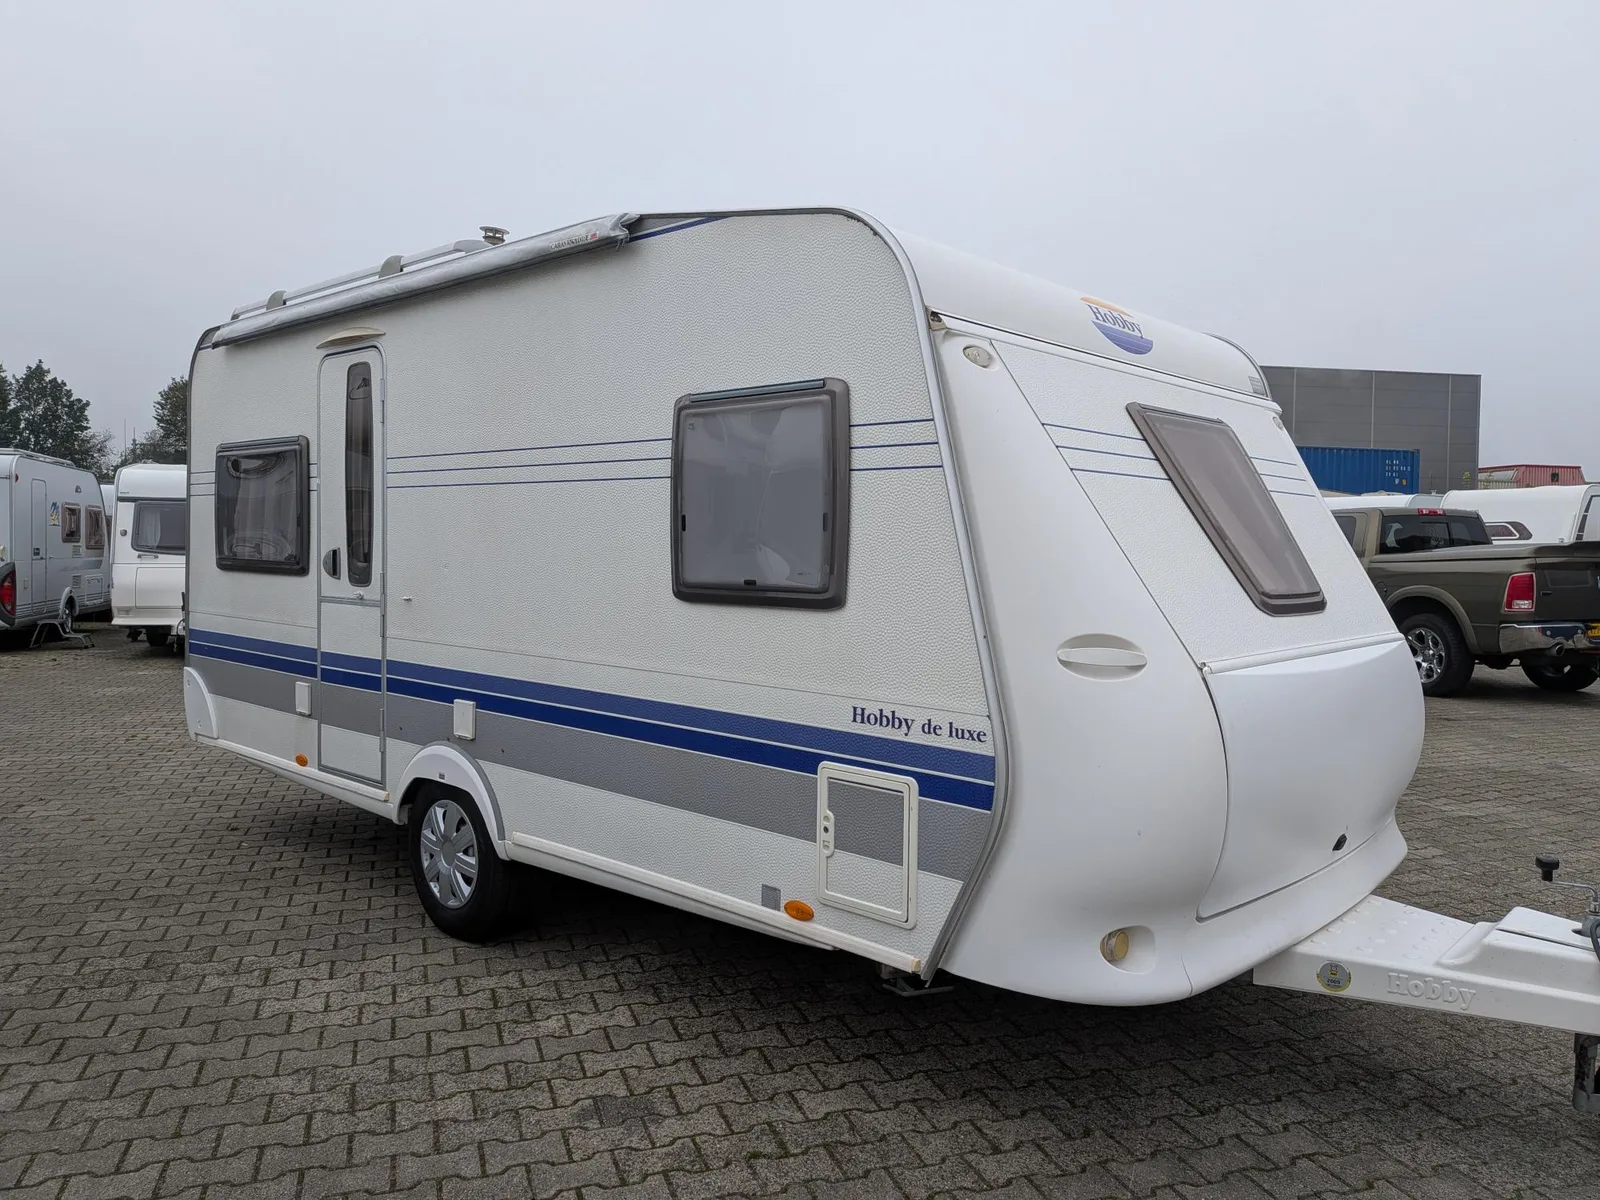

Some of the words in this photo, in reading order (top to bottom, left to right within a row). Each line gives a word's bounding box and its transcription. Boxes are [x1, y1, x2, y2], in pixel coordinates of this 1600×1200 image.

[1087, 304, 1144, 340] Hobby
[852, 706, 915, 737] Hobby
[921, 718, 943, 737] de
[948, 722, 987, 743] luxe
[1387, 972, 1476, 1010] Hobby
